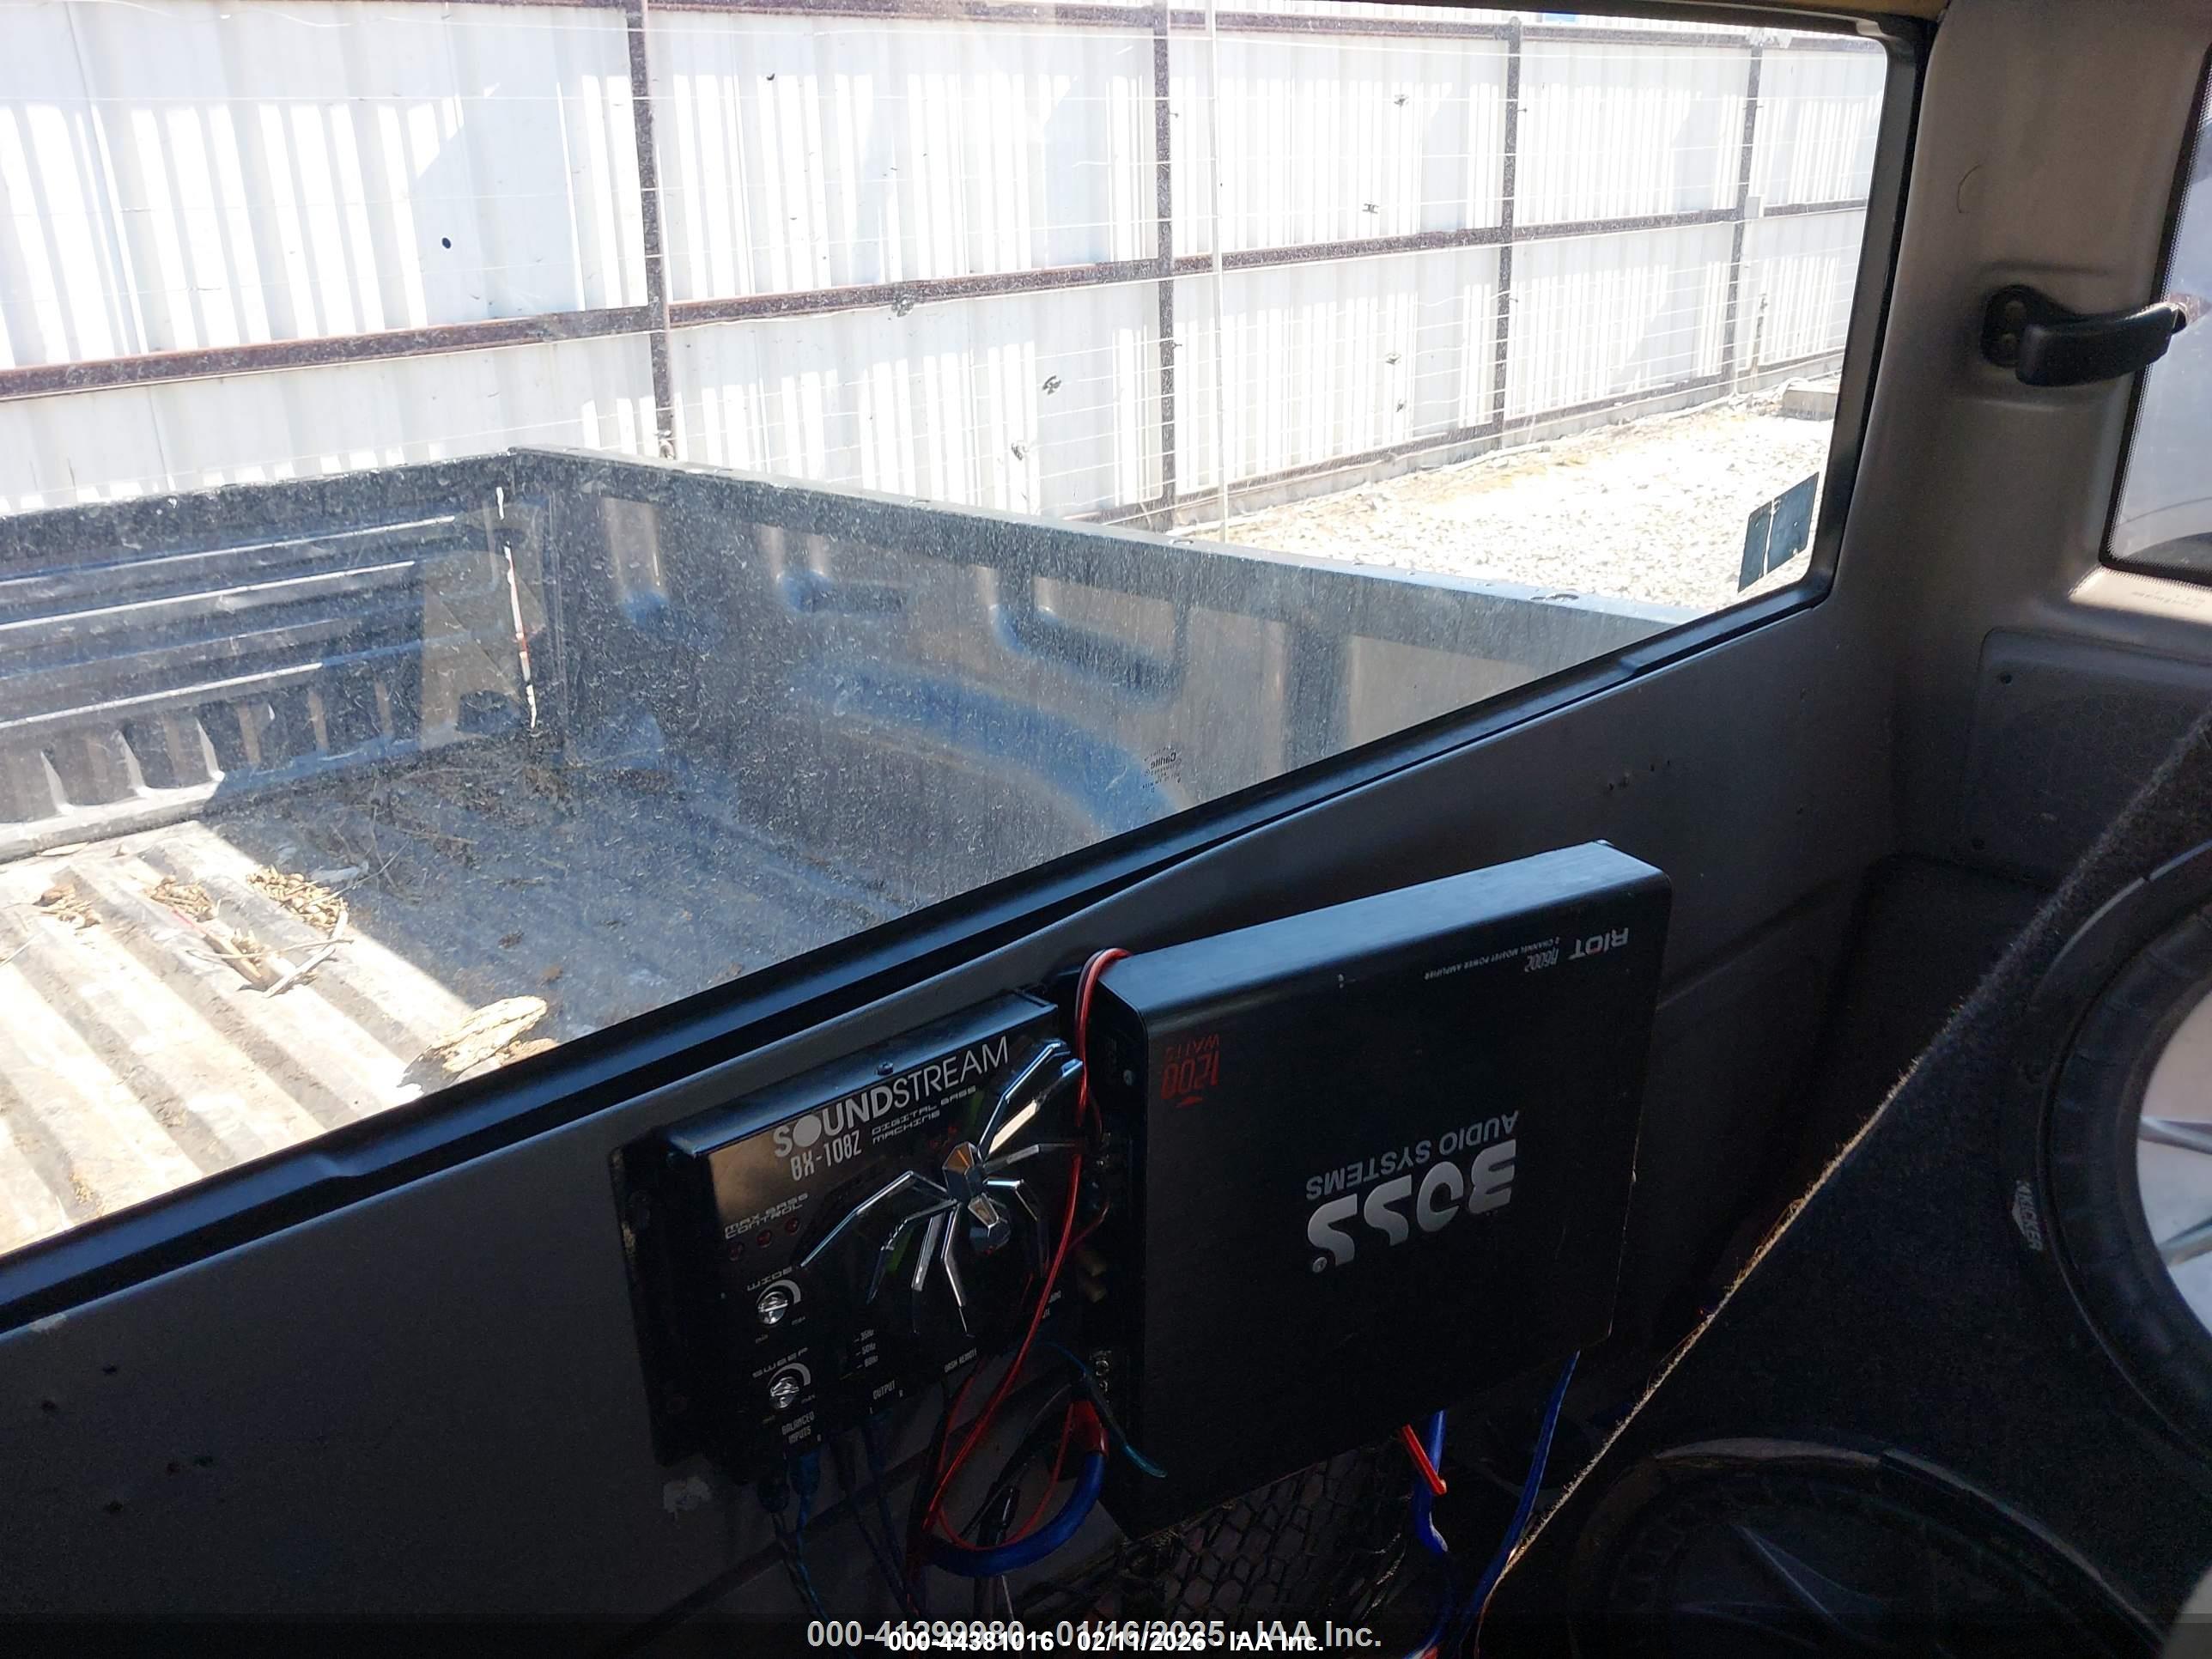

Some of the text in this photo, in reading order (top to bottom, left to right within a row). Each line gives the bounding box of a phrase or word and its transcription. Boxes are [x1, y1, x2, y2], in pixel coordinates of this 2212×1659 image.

[1463, 955, 1490, 969] POWER
[1568, 927, 1630, 962] RIOT
[1423, 961, 1462, 981] AMPLIFIER
[774, 1036, 1010, 1158] SOUNDSTREAM
[1304, 1109, 1519, 1201] AUDIO SYSTEMS
[1305, 1139, 1517, 1267] BOSS
[872, 1379, 896, 1401] OUTPUT
